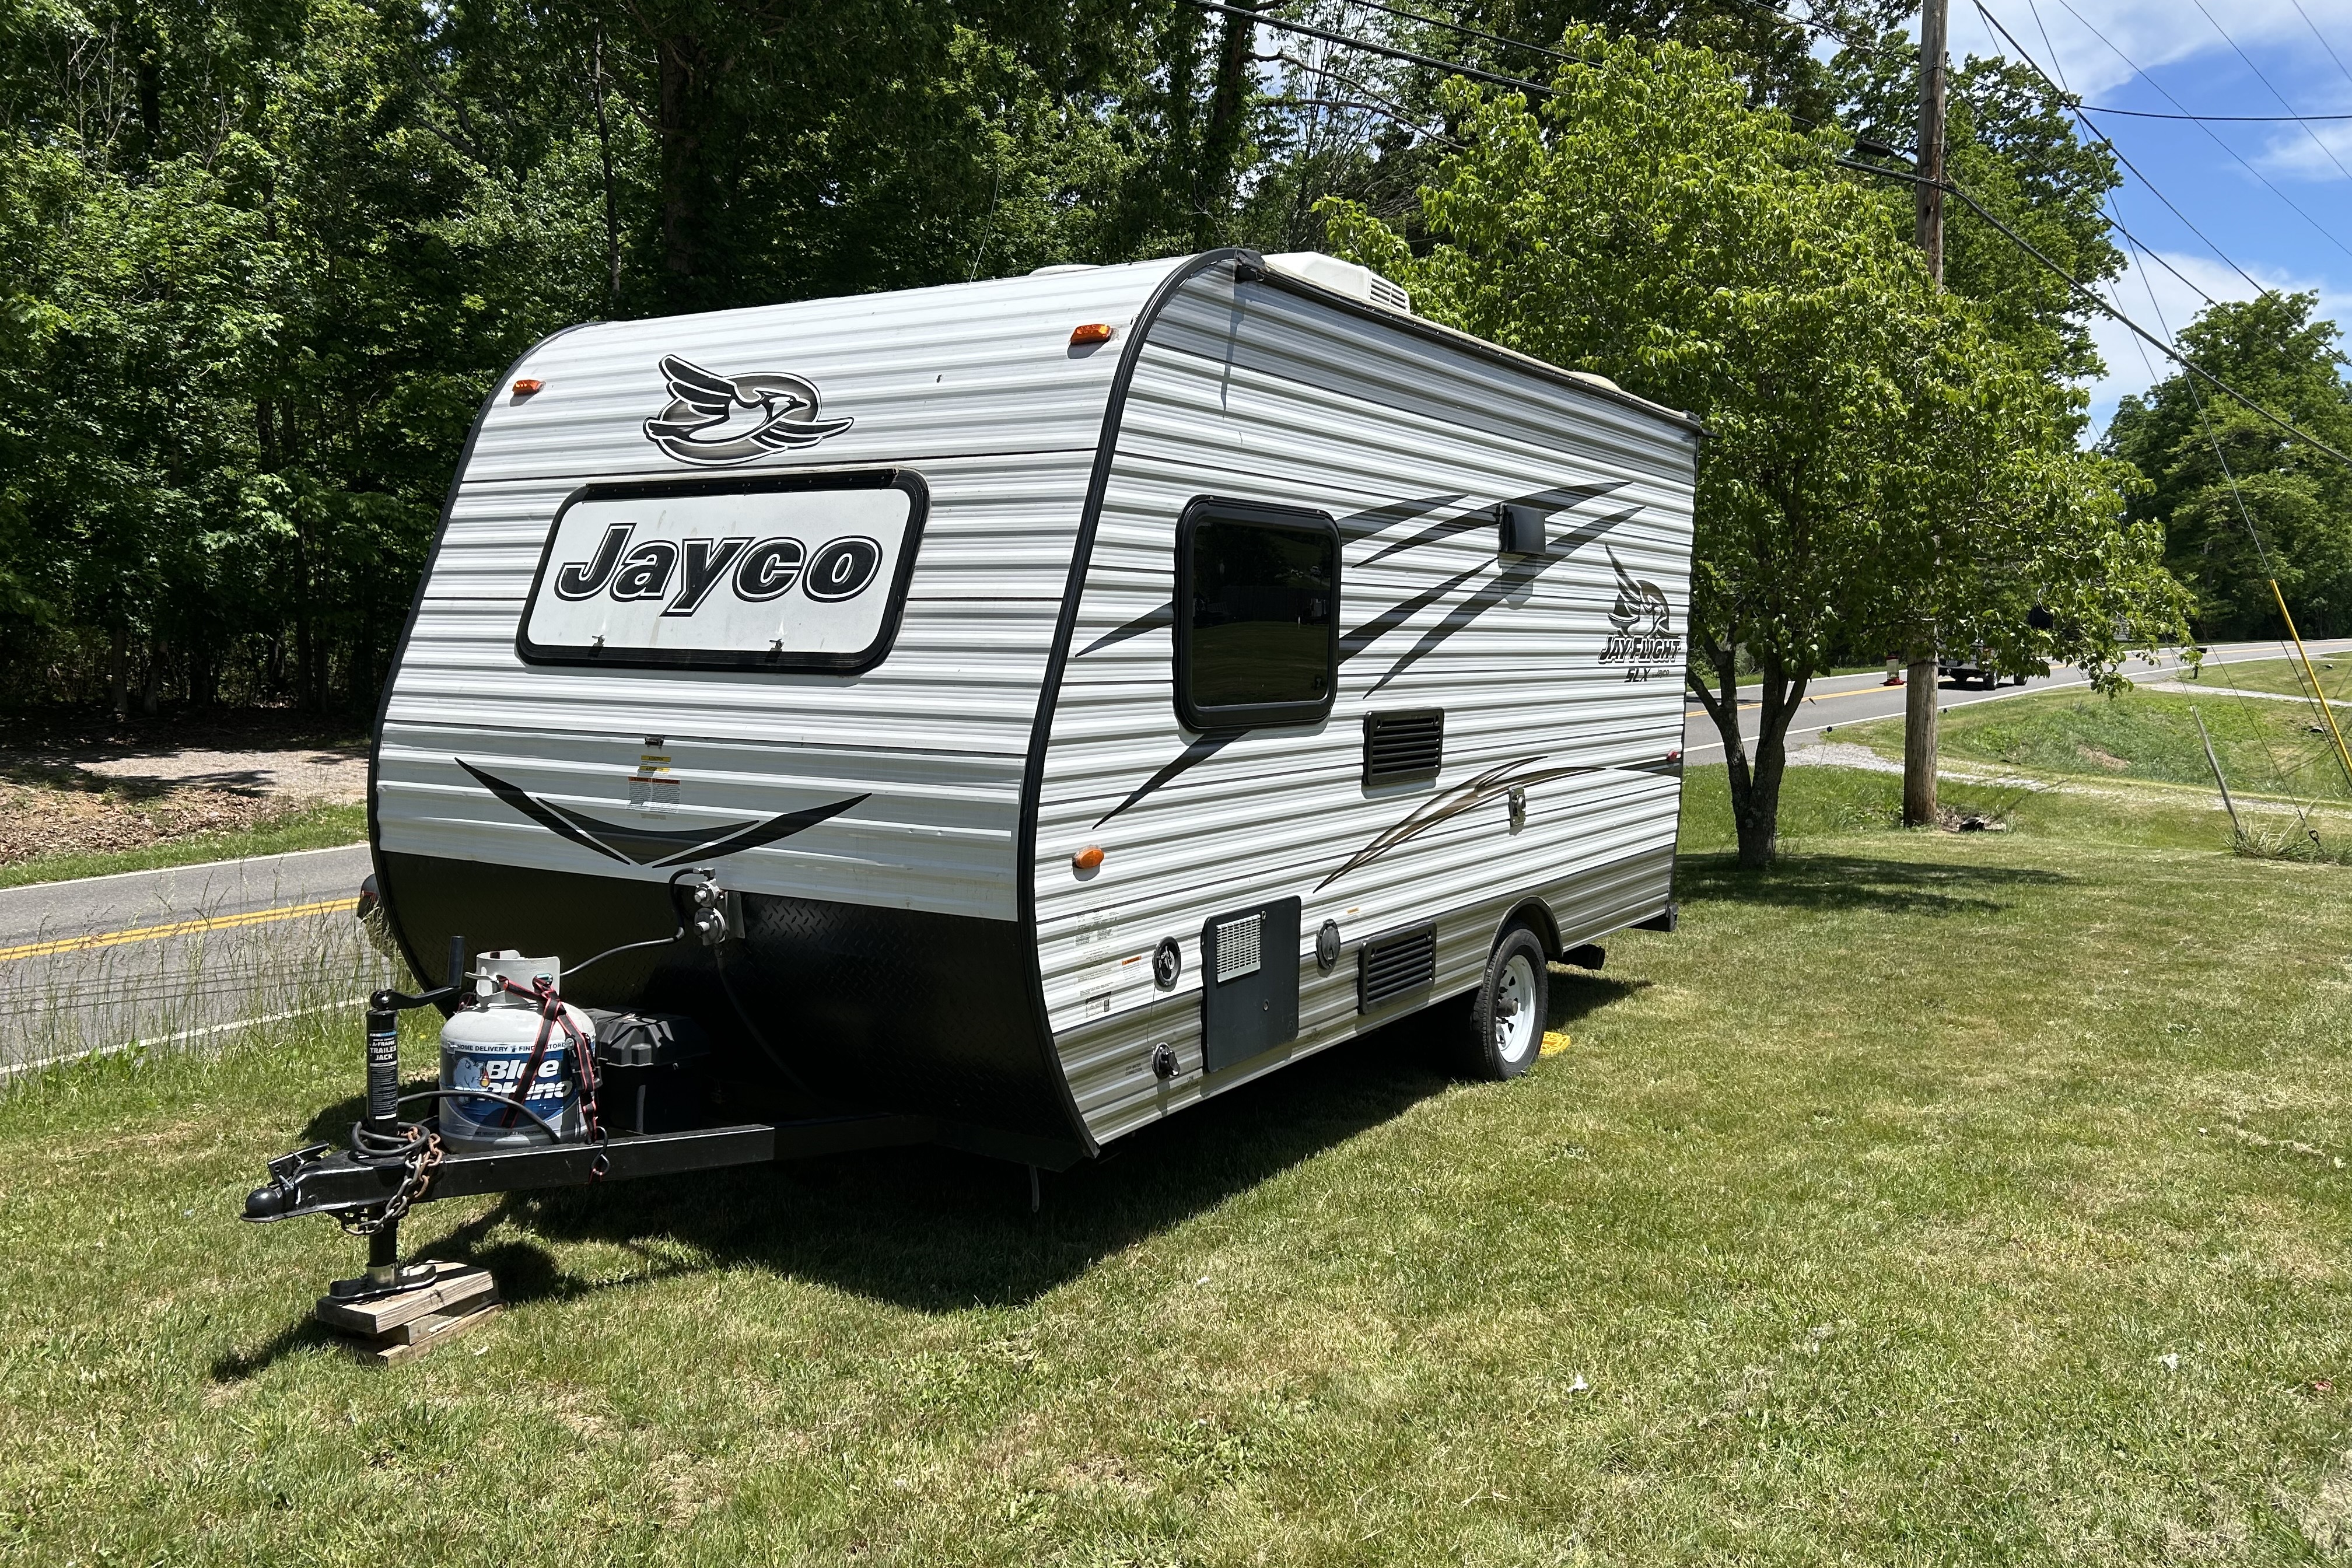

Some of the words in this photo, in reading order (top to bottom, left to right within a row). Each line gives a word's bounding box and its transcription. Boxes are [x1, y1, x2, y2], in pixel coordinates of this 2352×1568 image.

[554, 523, 883, 617] Jayco
[1598, 634, 1632, 664] JAY
[1628, 634, 1681, 663] FLIGHT
[1624, 667, 1651, 682] SLX
[370, 1045, 397, 1054] TRAILER
